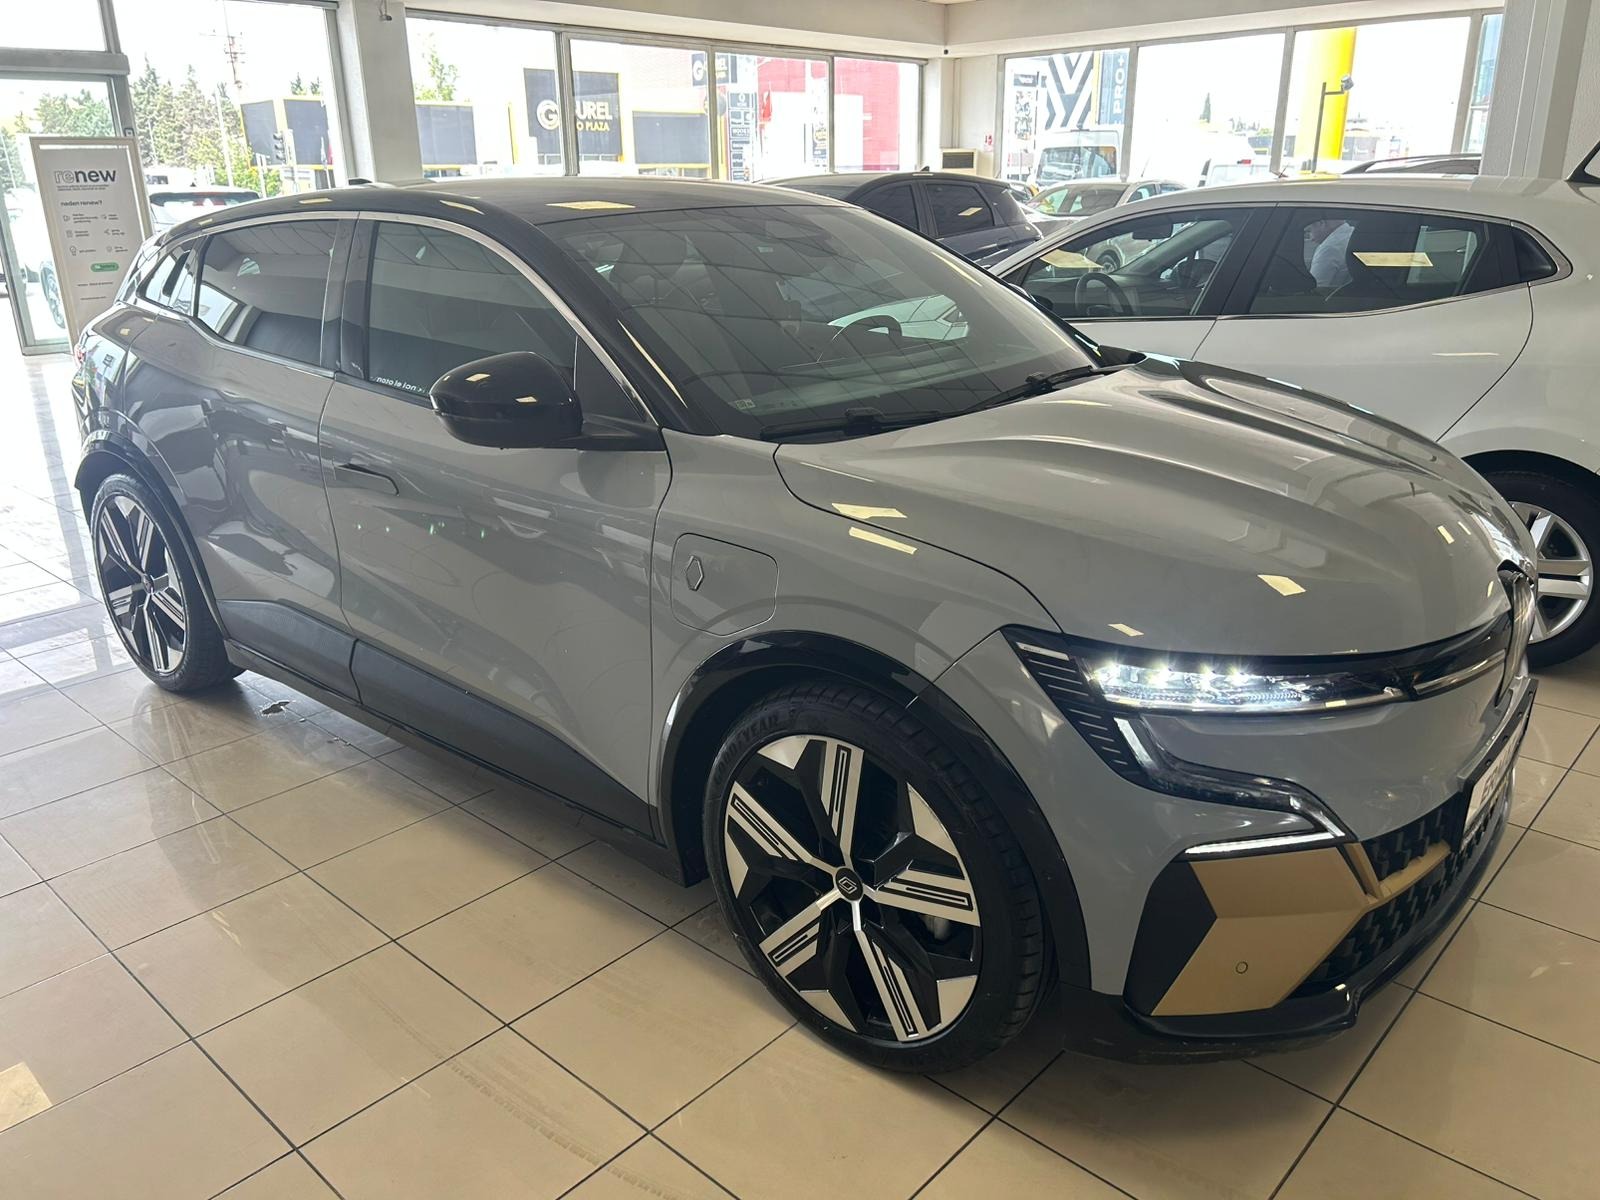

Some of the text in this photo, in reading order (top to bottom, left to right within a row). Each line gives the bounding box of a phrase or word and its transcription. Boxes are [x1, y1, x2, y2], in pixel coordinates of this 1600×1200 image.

[1113, 55, 1125, 114] PRO+
[586, 121, 610, 132] PLAZA
[54, 169, 117, 184] renew
